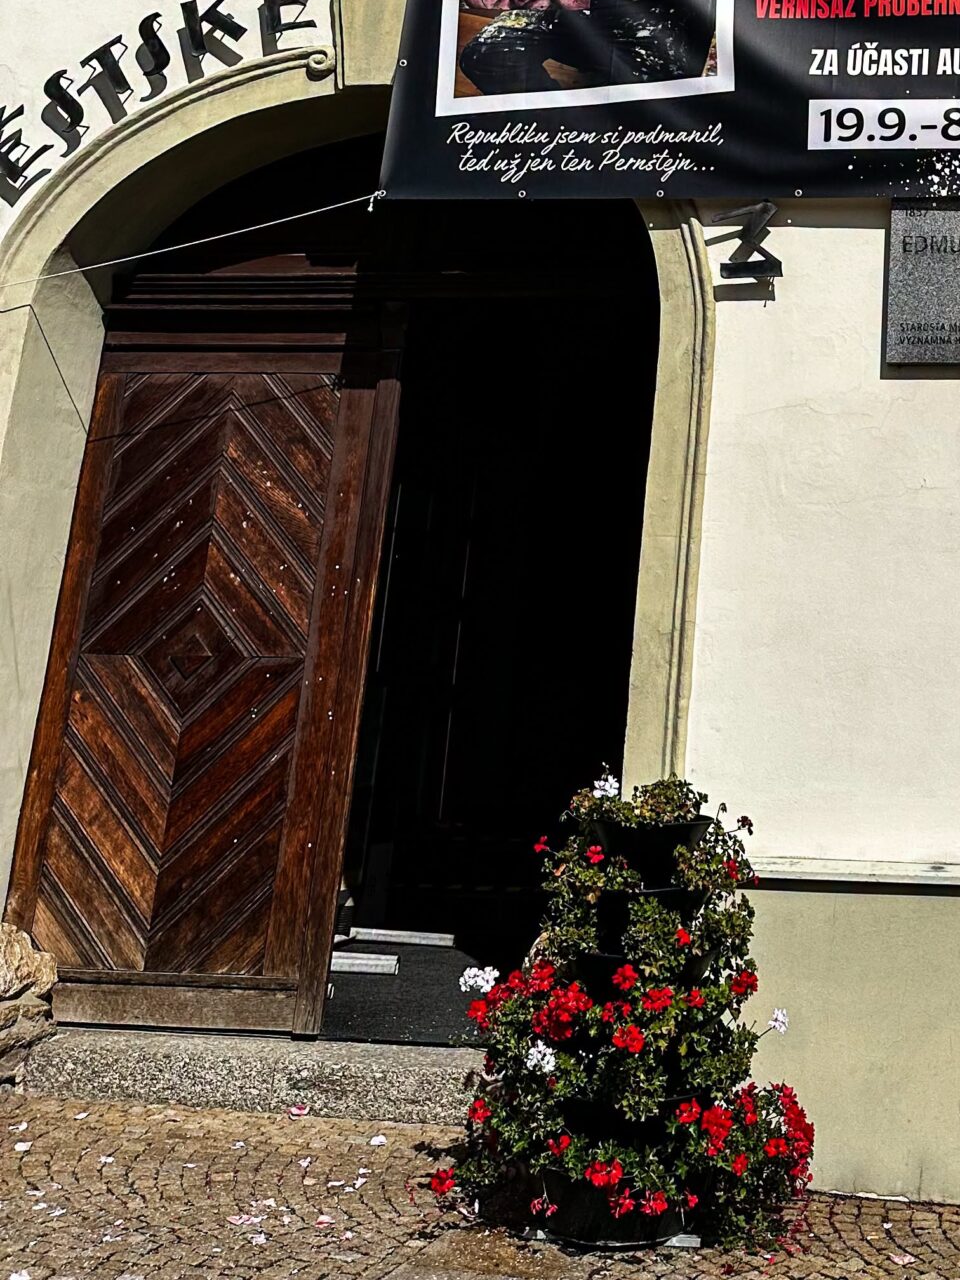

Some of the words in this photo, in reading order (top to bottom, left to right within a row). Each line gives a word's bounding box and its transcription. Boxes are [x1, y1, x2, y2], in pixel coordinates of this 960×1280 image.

[809, 48, 839, 77] ZA
[846, 41, 929, 77] ÚČASTI
[447, 122, 550, 147] Republiku
[548, 125, 601, 154] jsem
[600, 125, 620, 144] si
[617, 122, 725, 154] podmanil,
[458, 149, 499, 171] teď
[561, 152, 594, 171] ten
[899, 322, 946, 333] STAROSTA
